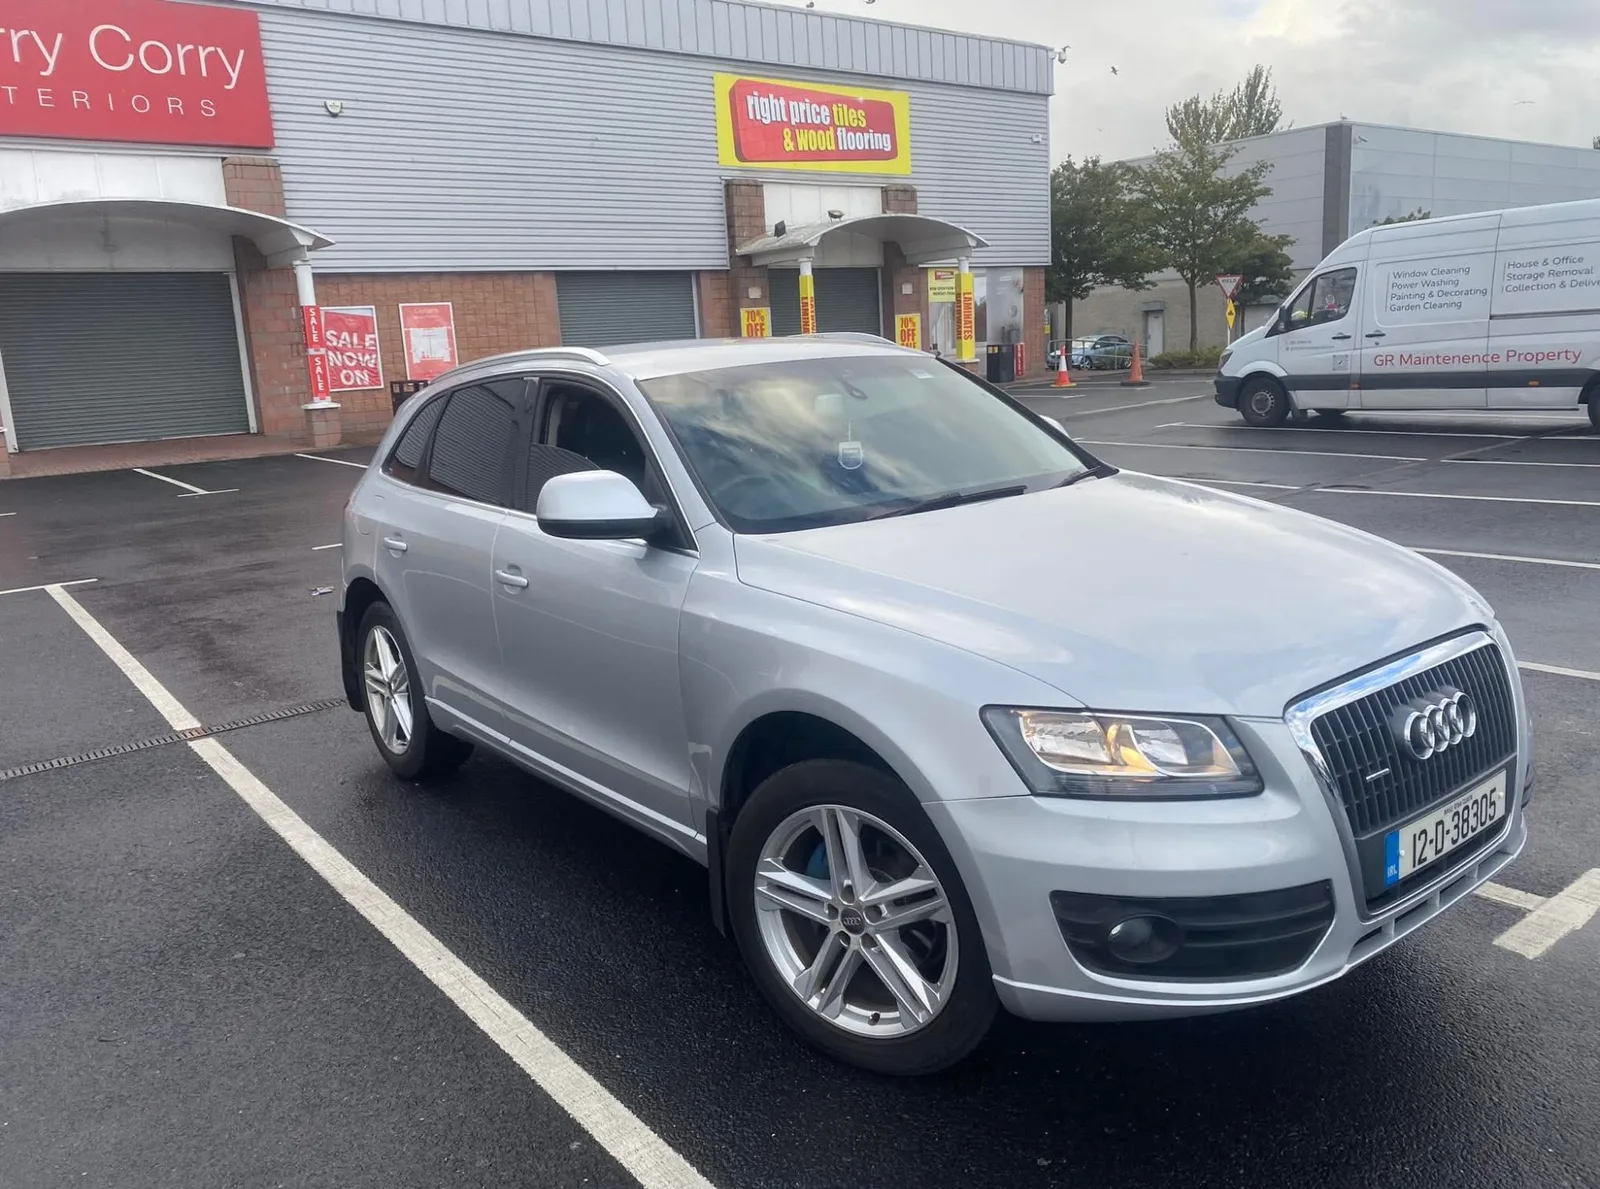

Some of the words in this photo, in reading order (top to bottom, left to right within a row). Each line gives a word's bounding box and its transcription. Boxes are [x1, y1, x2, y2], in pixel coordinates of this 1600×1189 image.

[0, 28, 63, 76] ry
[88, 24, 245, 90] Corry
[1, 86, 216, 117] TERIORS
[746, 91, 788, 124] right
[789, 98, 831, 125] price
[832, 103, 867, 127] tiles
[783, 127, 794, 152] &
[795, 127, 835, 151] wood
[837, 127, 891, 151] flooring
[1507, 260, 1539, 269] House
[1542, 258, 1549, 266] &
[1552, 256, 1584, 265] Office
[1393, 270, 1428, 279] Window
[1430, 266, 1471, 276] Cleaning
[1506, 271, 1545, 281] Storage
[1548, 266, 1593, 277] Removal
[1391, 281, 1418, 290] Power
[1420, 278, 1460, 288] Washing
[1505, 282, 1556, 293] Collection
[1559, 280, 1567, 288] &
[1390, 291, 1426, 301] Painting
[1428, 290, 1434, 298] &
[1437, 288, 1488, 298] Decorating
[1389, 302, 1421, 312] Garden
[1423, 300, 1462, 310] Cleaning
[746, 310, 765, 322] 70%
[900, 317, 916, 328] 70%
[963, 292, 973, 340] LAMINATES
[309, 308, 319, 342] SALE
[746, 323, 765, 337] OFF
[326, 330, 376, 349] SALE
[900, 328, 917, 342] OFF
[328, 351, 376, 367] NOW
[1374, 354, 1394, 366] GR
[1399, 352, 1500, 366] Maintenence
[1506, 349, 1582, 364] Property
[314, 357, 324, 391] SALE
[341, 370, 370, 385] ON
[1412, 787, 1496, 868] 12-D-38305
